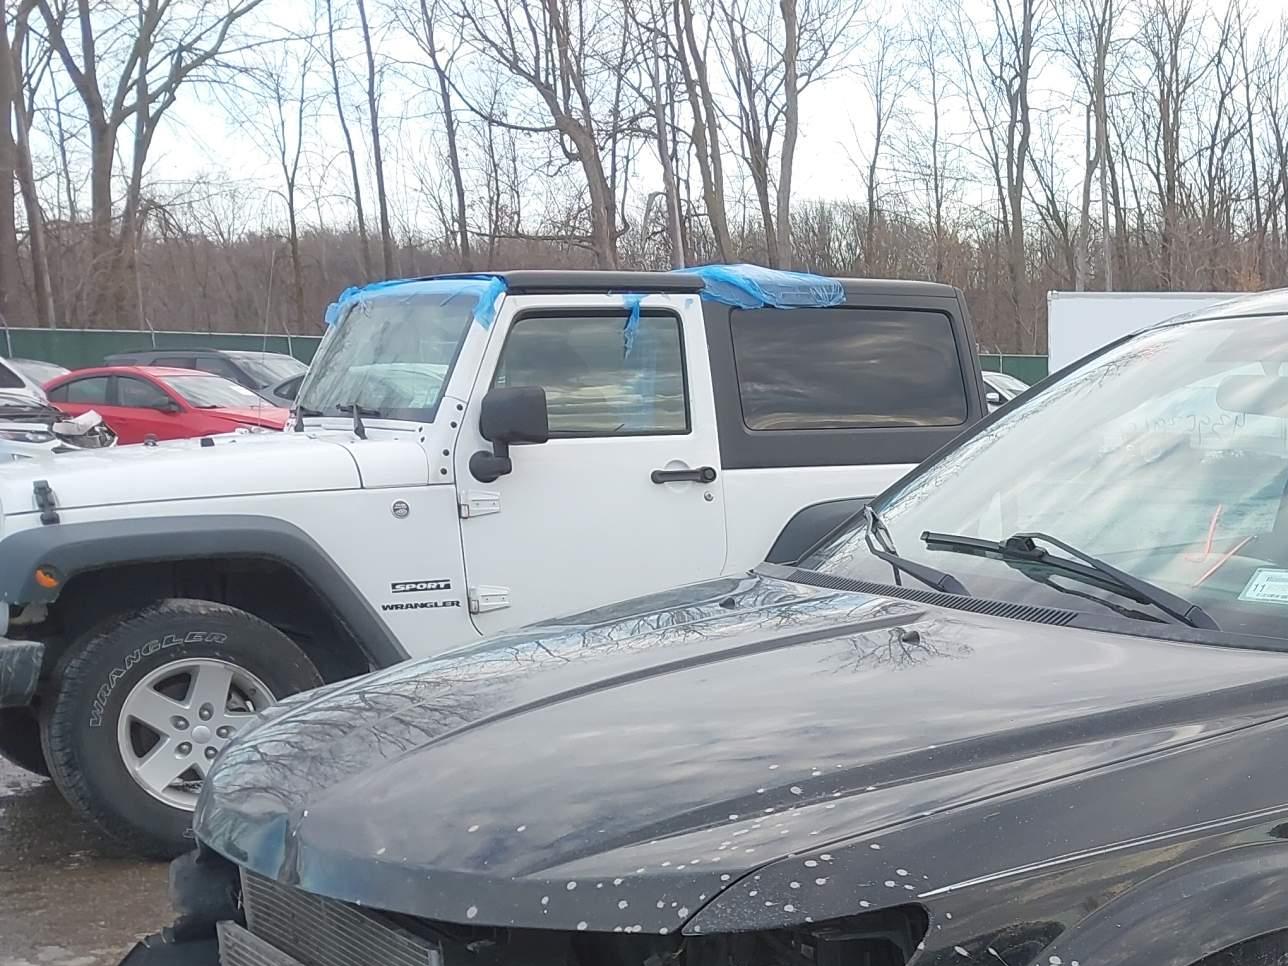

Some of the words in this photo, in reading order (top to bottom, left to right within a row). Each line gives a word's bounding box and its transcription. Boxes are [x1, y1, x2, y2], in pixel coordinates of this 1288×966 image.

[394, 582, 449, 591] SPORT
[1252, 583, 1266, 593] 11
[381, 600, 462, 611] WRANGLER
[89, 631, 228, 728] WRANGLER
